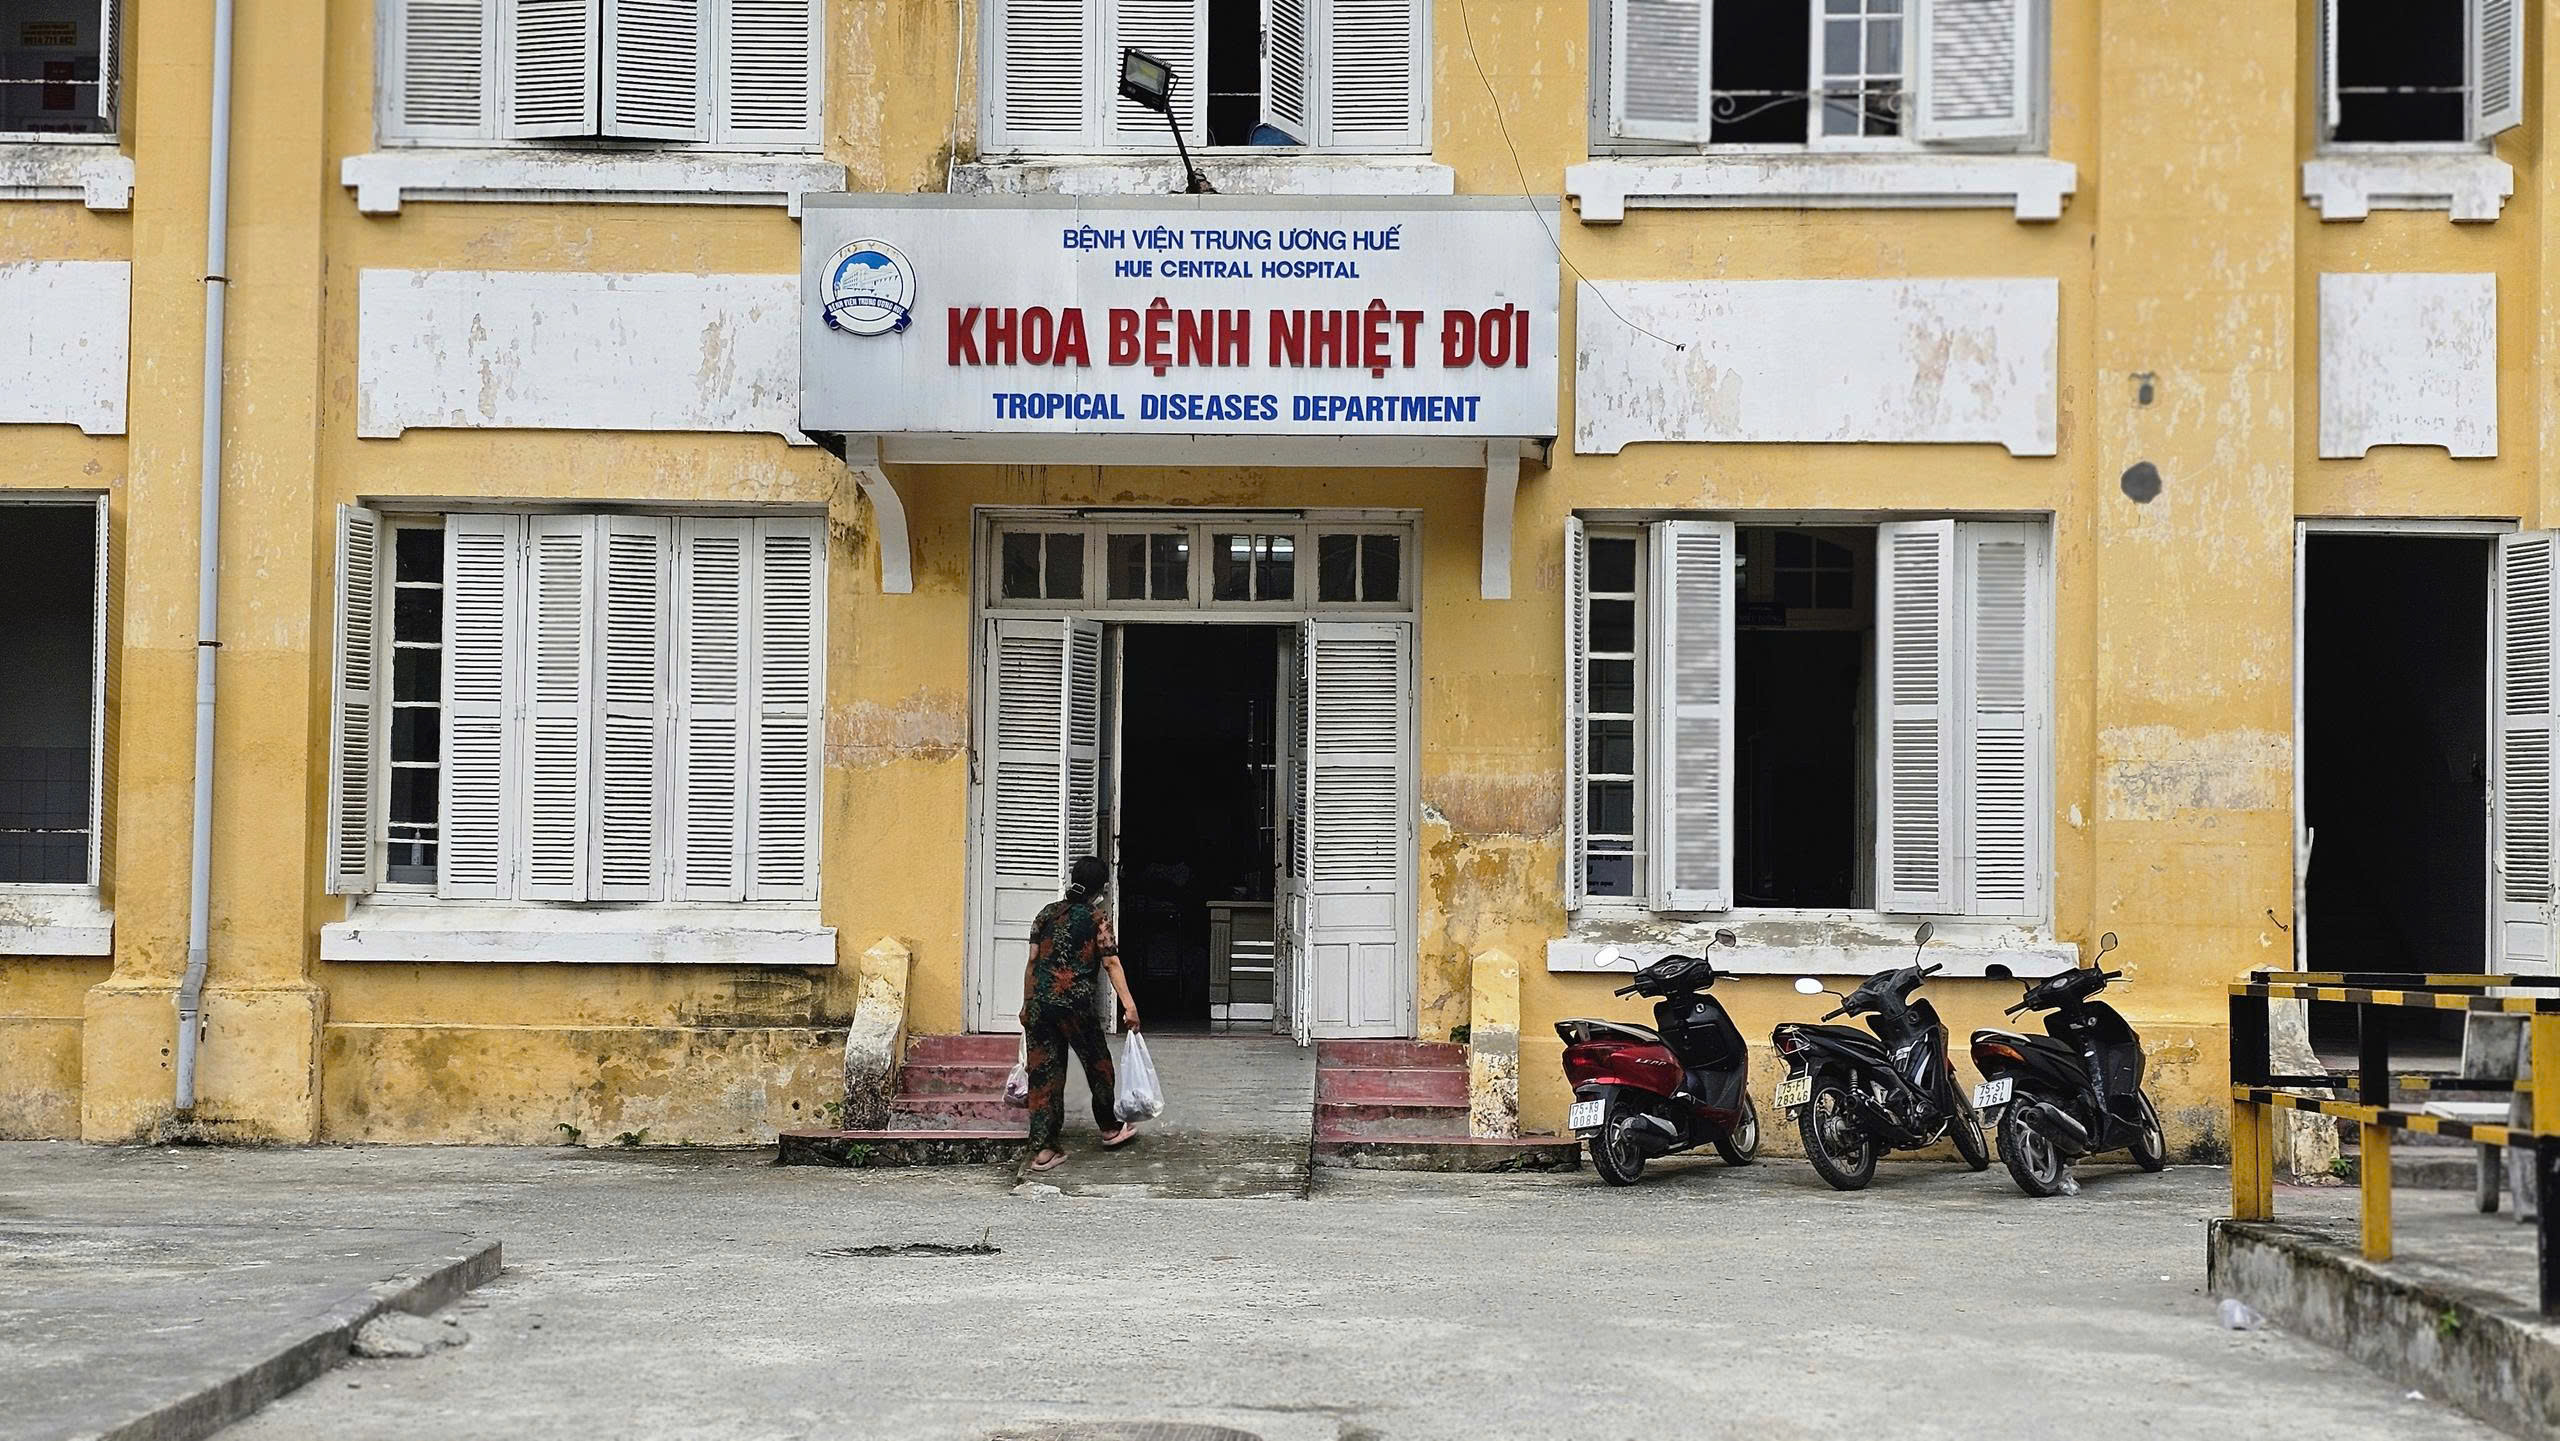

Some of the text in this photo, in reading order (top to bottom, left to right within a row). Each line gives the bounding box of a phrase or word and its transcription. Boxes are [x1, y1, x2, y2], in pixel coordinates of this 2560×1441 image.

[1063, 224, 1402, 253] BỆNH VIỆN TRUNG ƯƠNG HUẾ
[1115, 260, 1360, 279] HUE CENTRAL HOSPITAL
[948, 306, 1091, 367] KHOA
[1109, 297, 1250, 377] BỆNH
[1270, 299, 1424, 378] NHIỆT
[992, 392, 1482, 423] TROPICAL DISEASES DEPARTMENT
[1782, 1078, 1806, 1094] 75-F1
[1980, 1081, 2005, 1096] 75-S1
[1979, 1093, 2004, 1107] 7764
[1573, 1113, 1598, 1128] 0089
